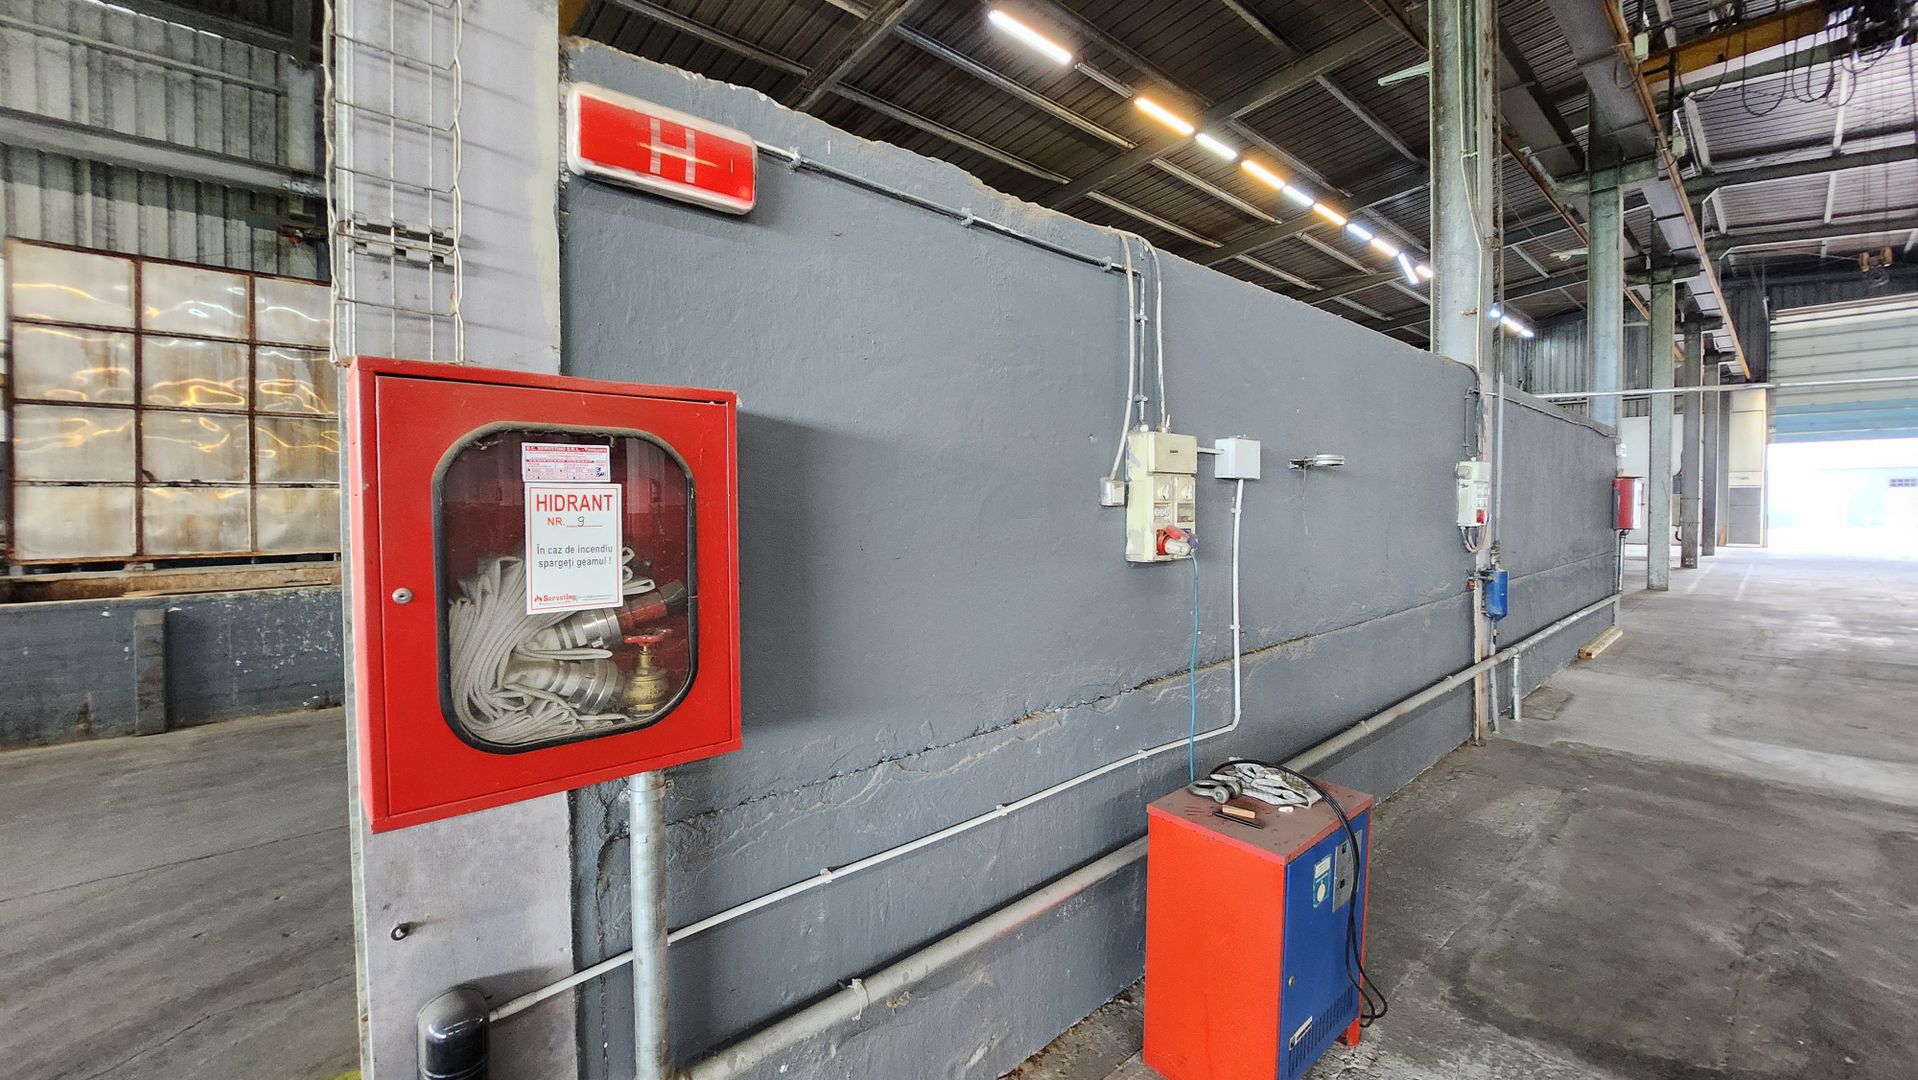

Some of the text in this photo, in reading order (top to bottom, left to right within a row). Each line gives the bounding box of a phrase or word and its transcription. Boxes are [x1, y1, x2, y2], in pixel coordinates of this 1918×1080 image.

[650, 117, 696, 184] H
[536, 494, 613, 511] HIDRANT
[547, 516, 585, 527] NR. 9
[537, 544, 545, 554] În
[565, 545, 575, 553] de
[578, 544, 612, 553] incendiu
[577, 557, 606, 568] geamul
